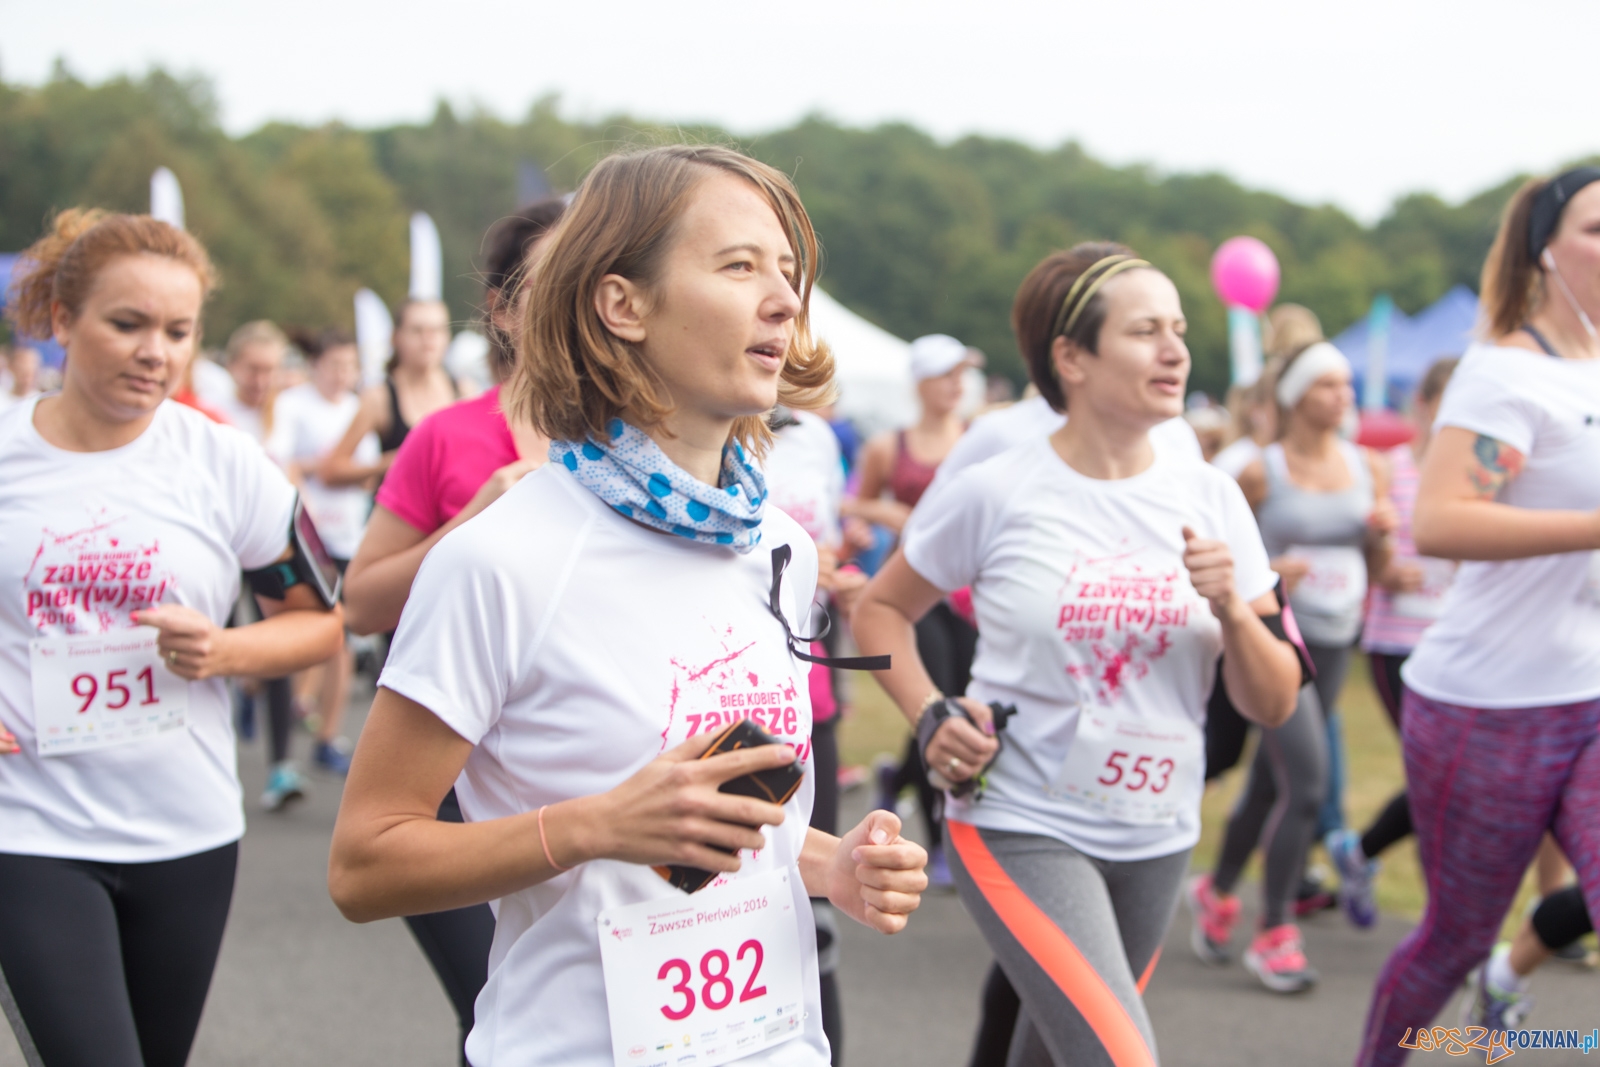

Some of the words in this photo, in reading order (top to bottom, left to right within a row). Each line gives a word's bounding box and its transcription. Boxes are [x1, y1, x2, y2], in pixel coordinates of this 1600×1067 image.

[43, 560, 152, 585] zawsze
[27, 580, 167, 616] pier(w)si!
[1078, 582, 1173, 602] zawsze
[37, 611, 76, 629] 2016
[1057, 602, 1189, 632] pier(w)si!
[70, 664, 160, 714] 951
[720, 694, 745, 708] BIEG
[747, 692, 781, 706] KOBIET
[1098, 750, 1175, 794] 553
[649, 917, 694, 936] Zawsze
[696, 903, 741, 925] Pier(w)si
[743, 896, 768, 914] 2016
[657, 938, 767, 1021] 382
